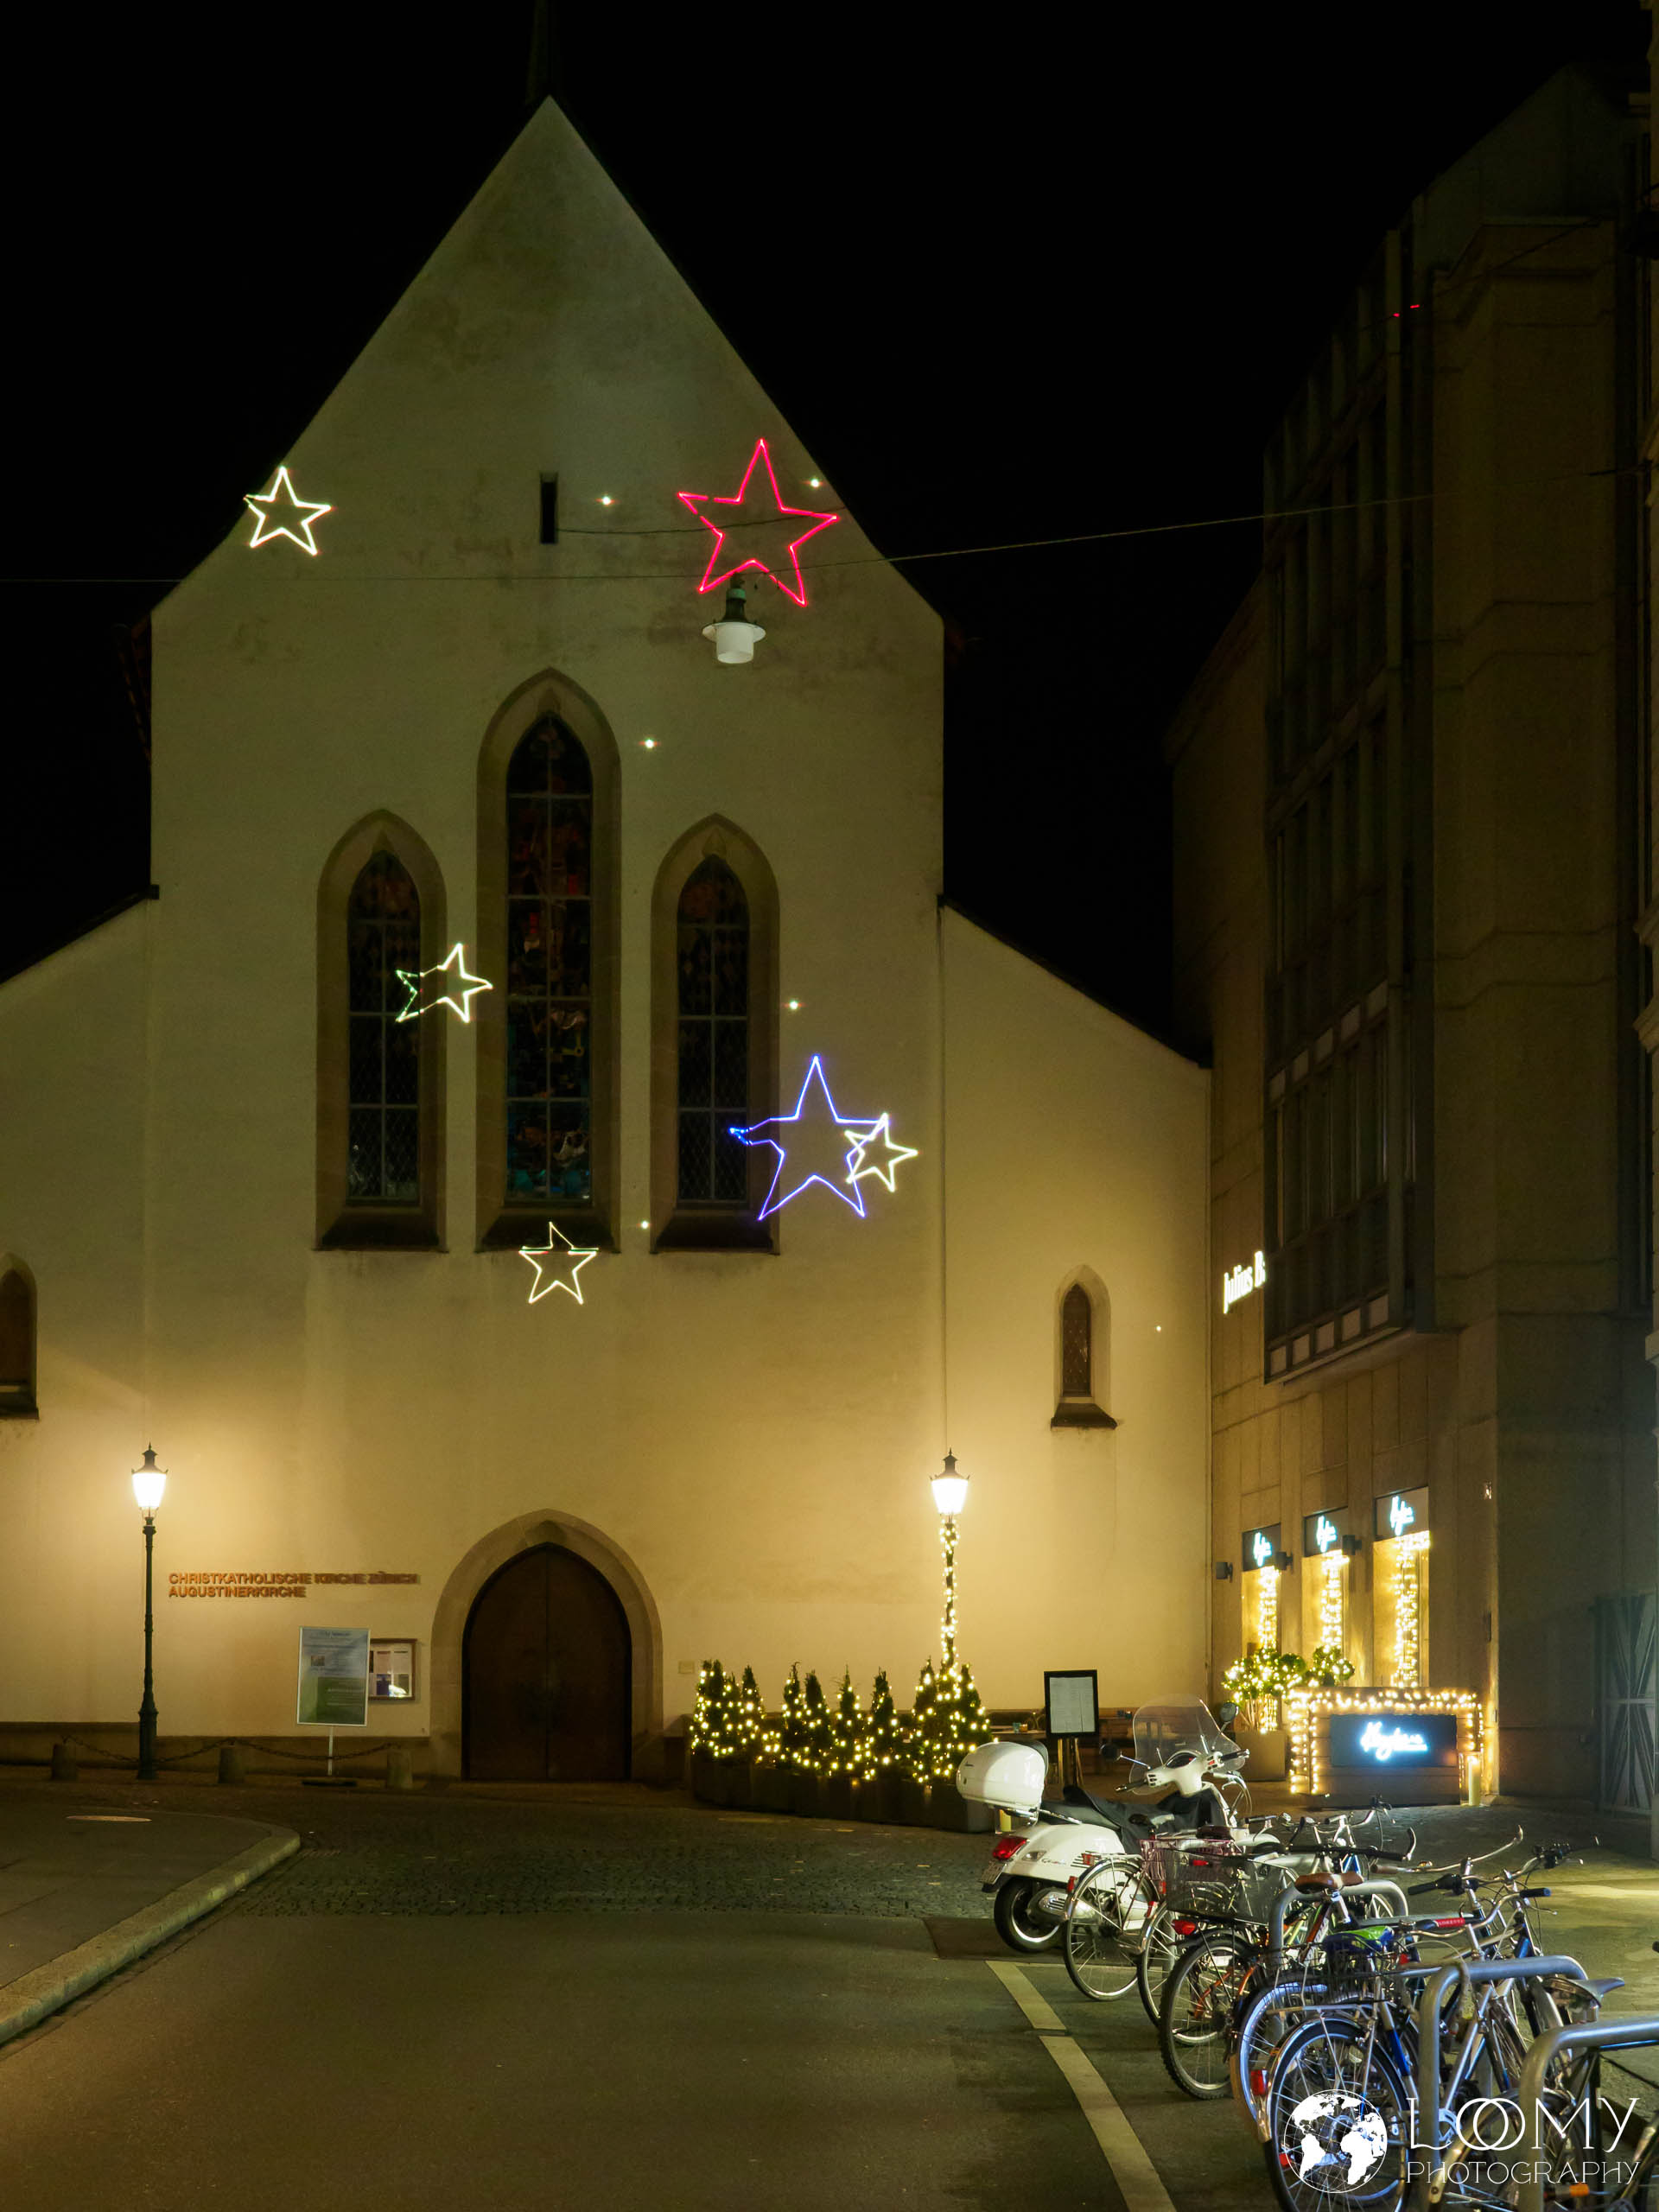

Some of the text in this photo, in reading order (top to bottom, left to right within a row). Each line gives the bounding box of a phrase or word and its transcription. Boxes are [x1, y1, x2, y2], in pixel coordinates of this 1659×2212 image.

[1224, 1264, 1253, 1314] Julius
[168, 1572, 312, 1585] CHRISTKATHOLISCHE
[314, 1573, 366, 1585] KIRCHE
[168, 1586, 307, 1598] AUGUSTINERKIRCHE
